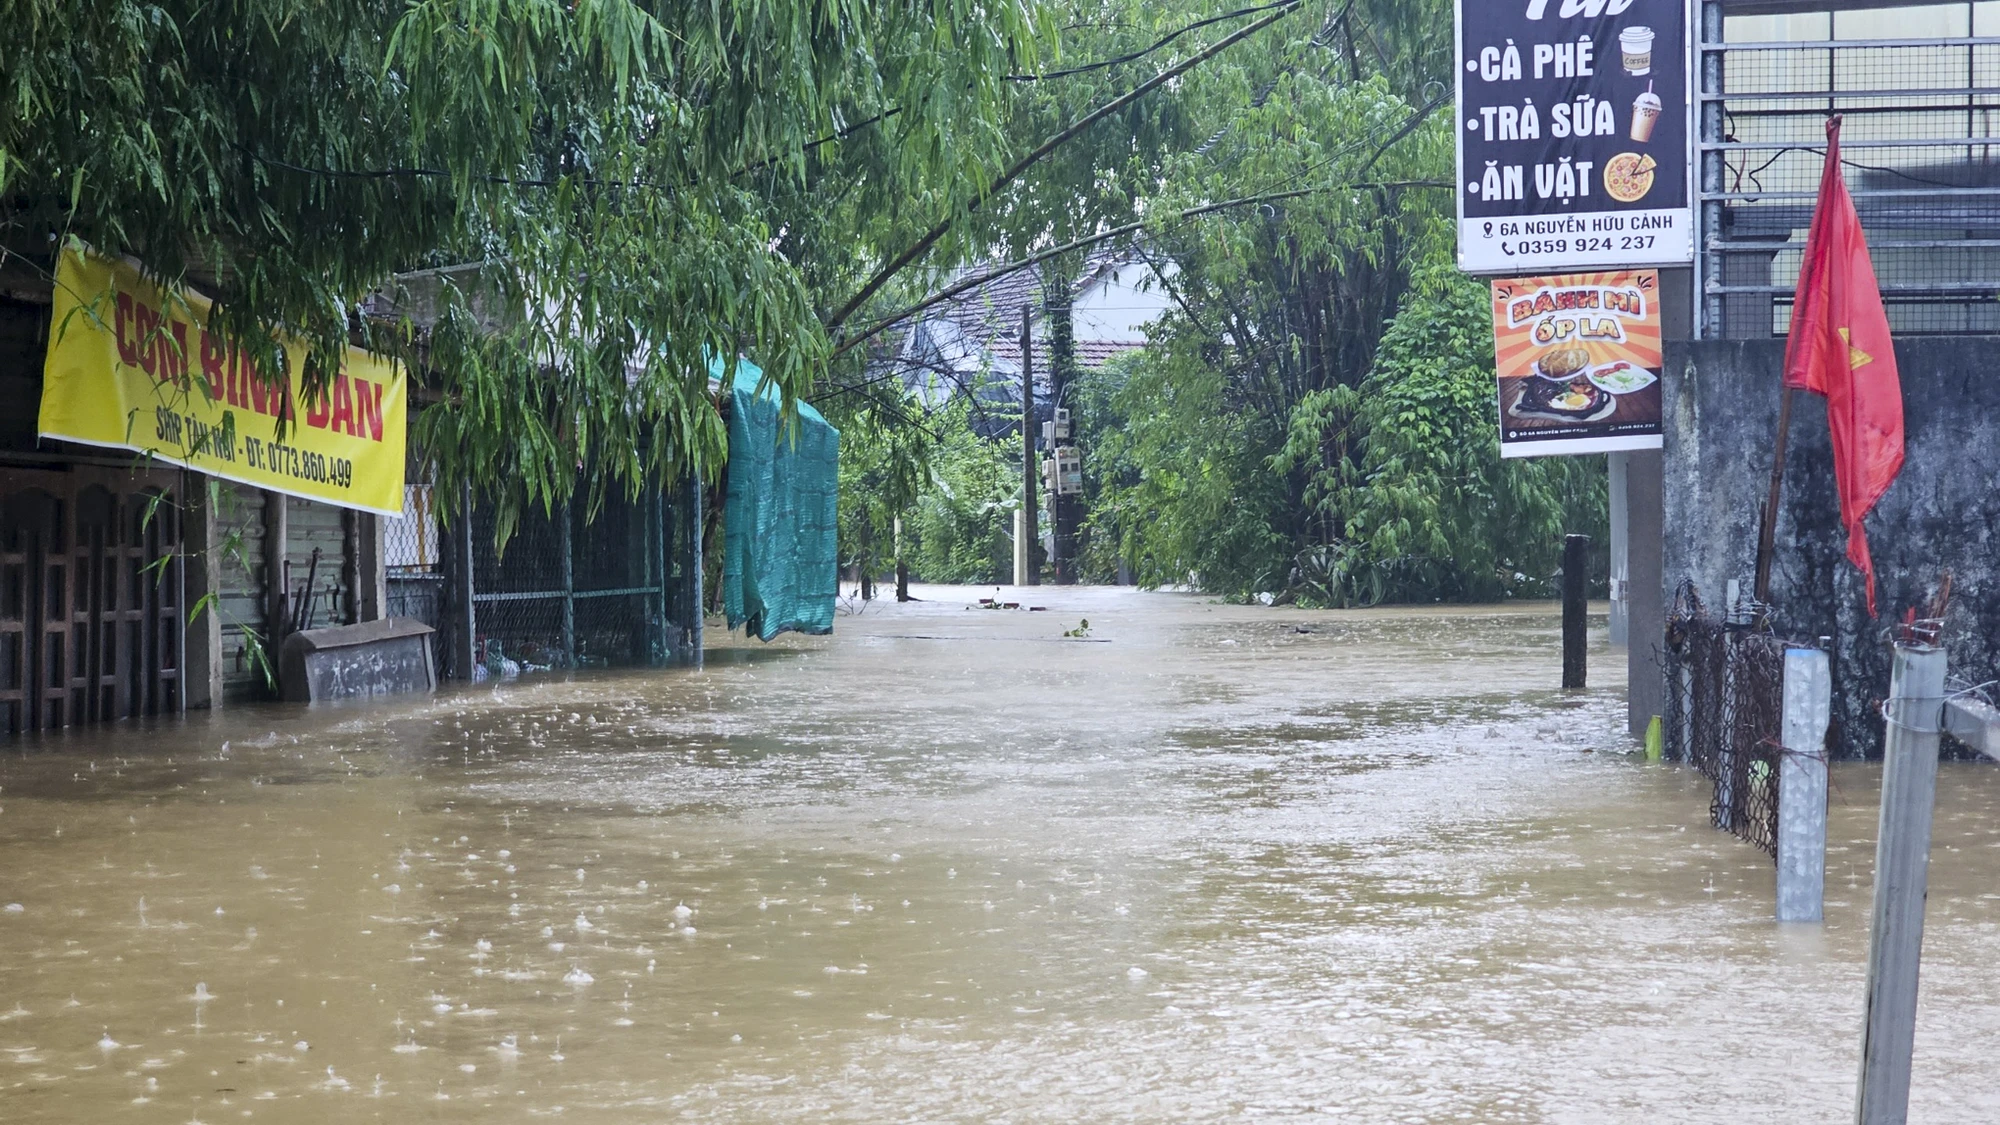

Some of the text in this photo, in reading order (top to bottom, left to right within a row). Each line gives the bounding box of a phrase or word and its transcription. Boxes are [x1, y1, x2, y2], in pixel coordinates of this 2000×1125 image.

[1480, 34, 1594, 82] CÀ PHÊ
[1480, 94, 1616, 141] TRÀ SỮA
[1482, 156, 1593, 205] ĂN VẶT
[1500, 213, 1673, 236] 6A NGUYỄN HỮU CẢNH
[1518, 235, 1656, 255] 0359 924 237
[1512, 290, 1641, 323] BÁNH MÌ
[1536, 315, 1621, 342] ỐP LA
[267, 441, 352, 489] 0773.860.499
